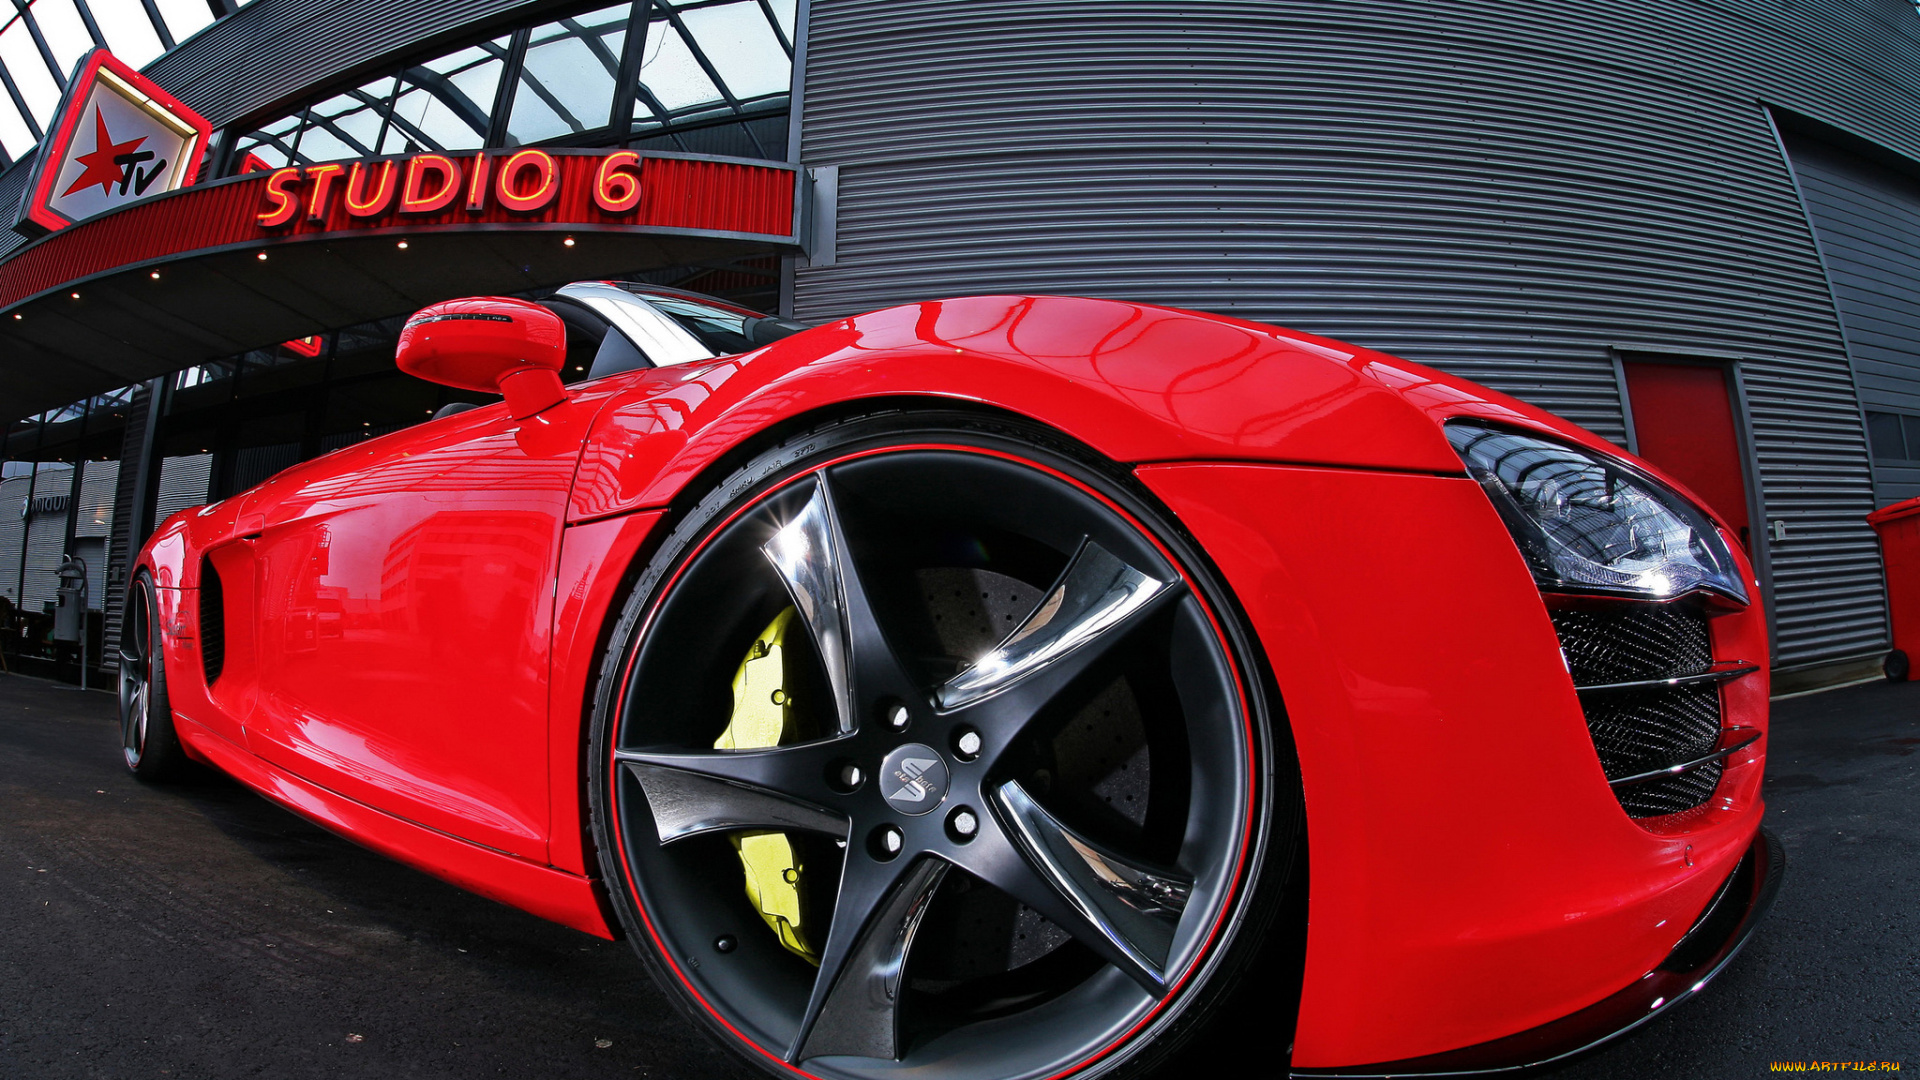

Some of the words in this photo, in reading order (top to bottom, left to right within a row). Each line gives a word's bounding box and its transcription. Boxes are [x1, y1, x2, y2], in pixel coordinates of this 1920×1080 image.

[113, 150, 168, 197] TV
[257, 149, 560, 227] STUDIO
[593, 151, 642, 214] 6
